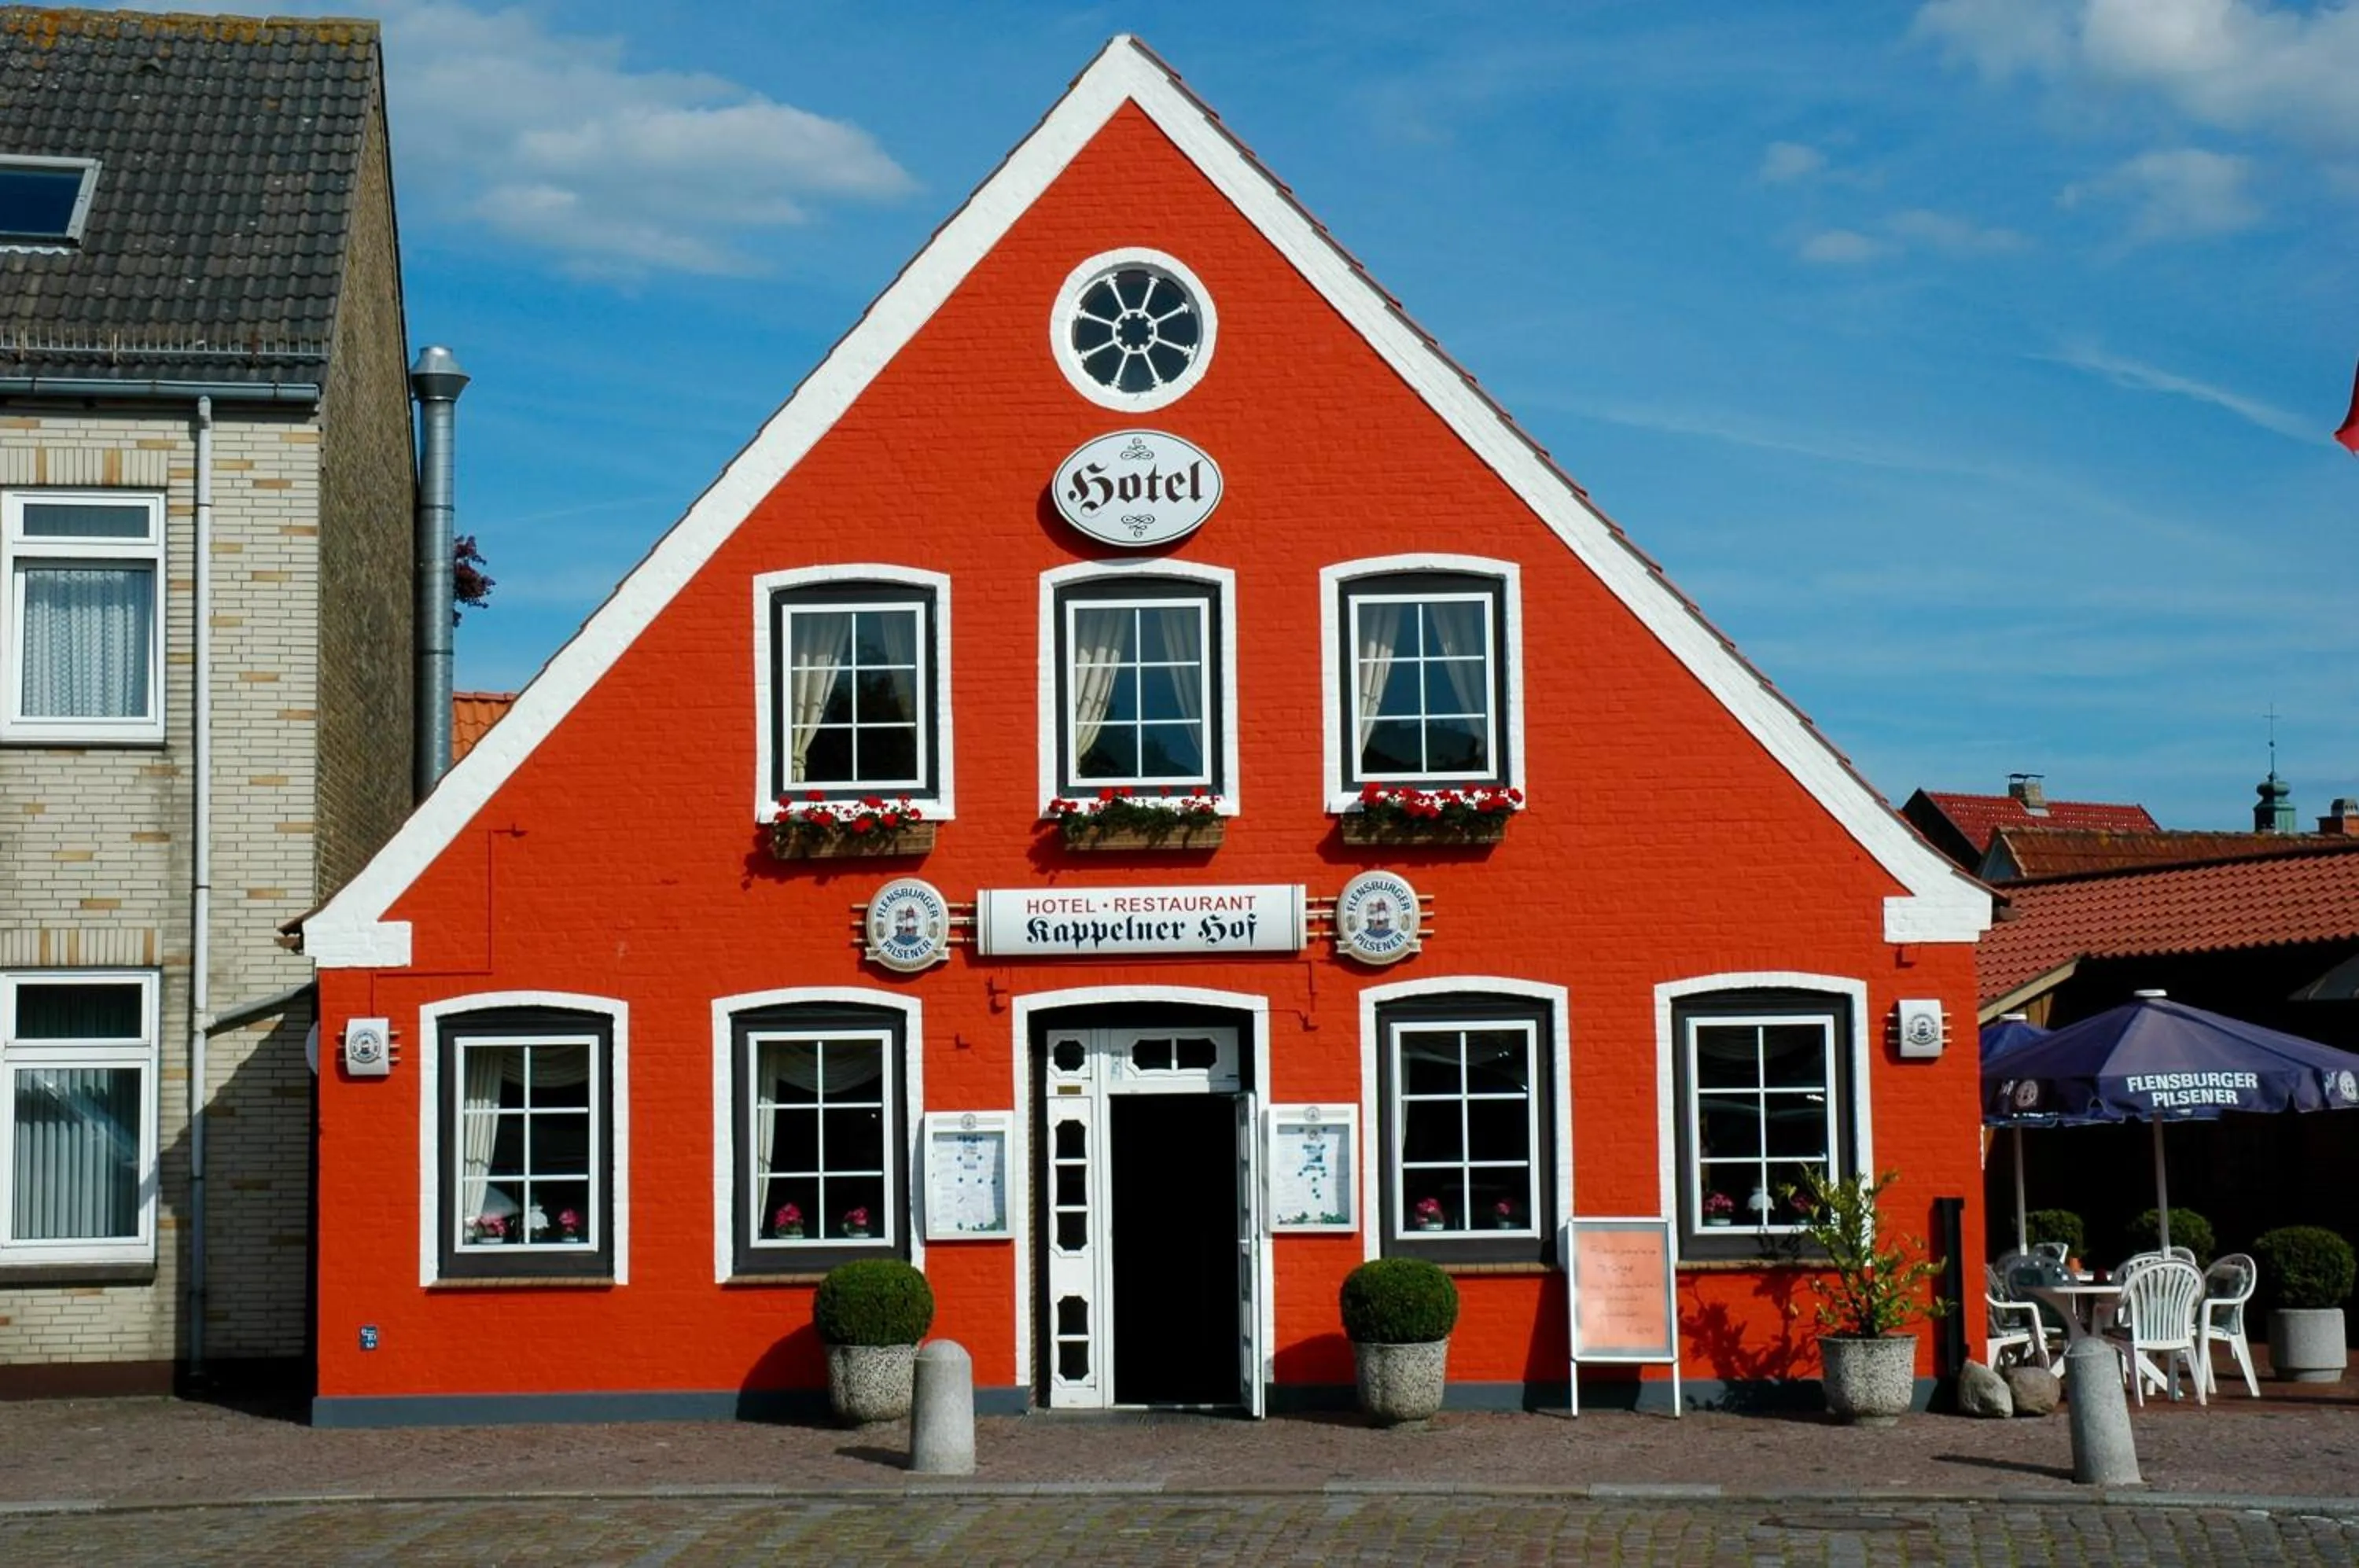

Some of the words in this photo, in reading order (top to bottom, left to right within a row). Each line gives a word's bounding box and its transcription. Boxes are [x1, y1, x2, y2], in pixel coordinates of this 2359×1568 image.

[1067, 458, 1204, 519] Hotel
[875, 888, 940, 918] FLENSBURGER
[1027, 898, 1096, 914] HOTEL
[1113, 896, 1257, 913] RESTAURANT
[1345, 881, 1411, 912] FLENSBURGER
[1026, 914, 1186, 950] Kappelner
[1198, 912, 1258, 948] Hof
[1353, 931, 1406, 952] PILSENER
[881, 939, 933, 959] PILSENER
[2125, 1071, 2258, 1092] FLENSBURGER
[2151, 1088, 2239, 1107] PILSENER
